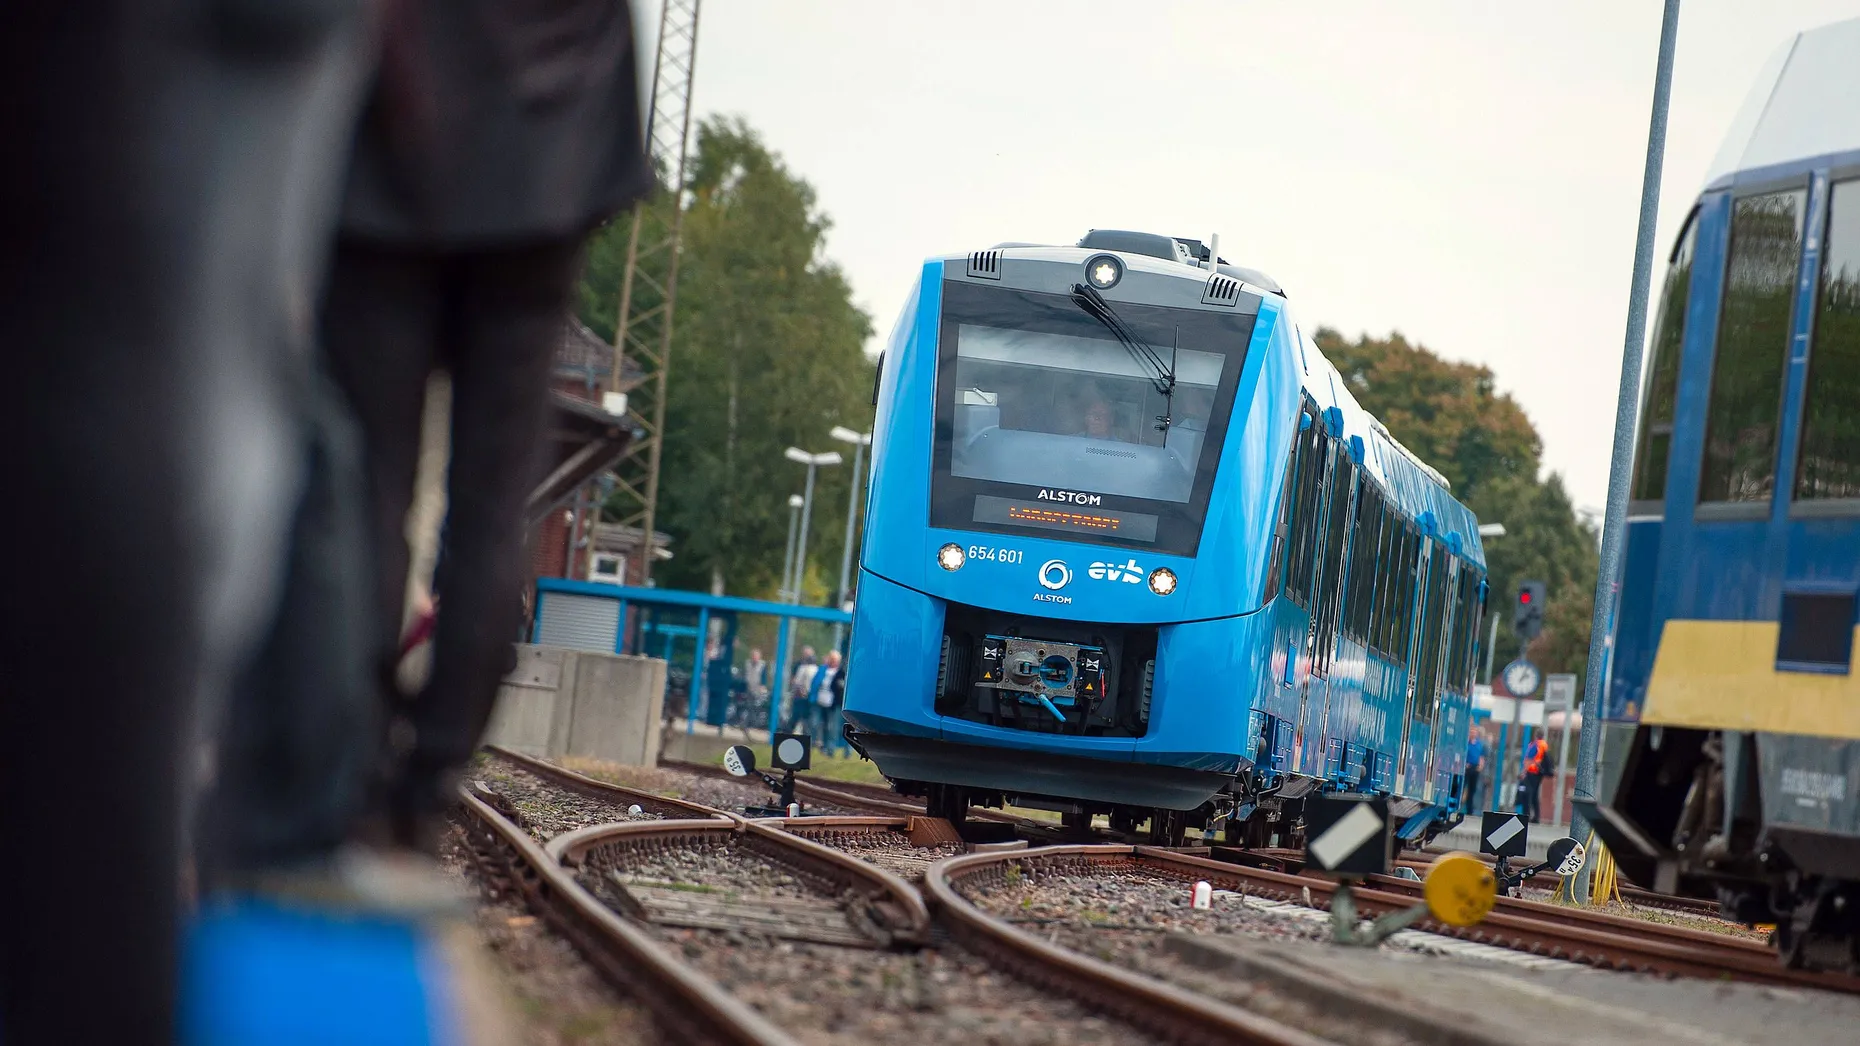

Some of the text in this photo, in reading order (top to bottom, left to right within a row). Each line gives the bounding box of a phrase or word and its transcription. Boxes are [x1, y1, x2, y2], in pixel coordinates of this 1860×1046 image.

[1037, 489, 1102, 506] ALSTOM
[968, 545, 1023, 564] 654 601
[1088, 559, 1144, 584] evb
[1033, 593, 1072, 605] ALSTOM
